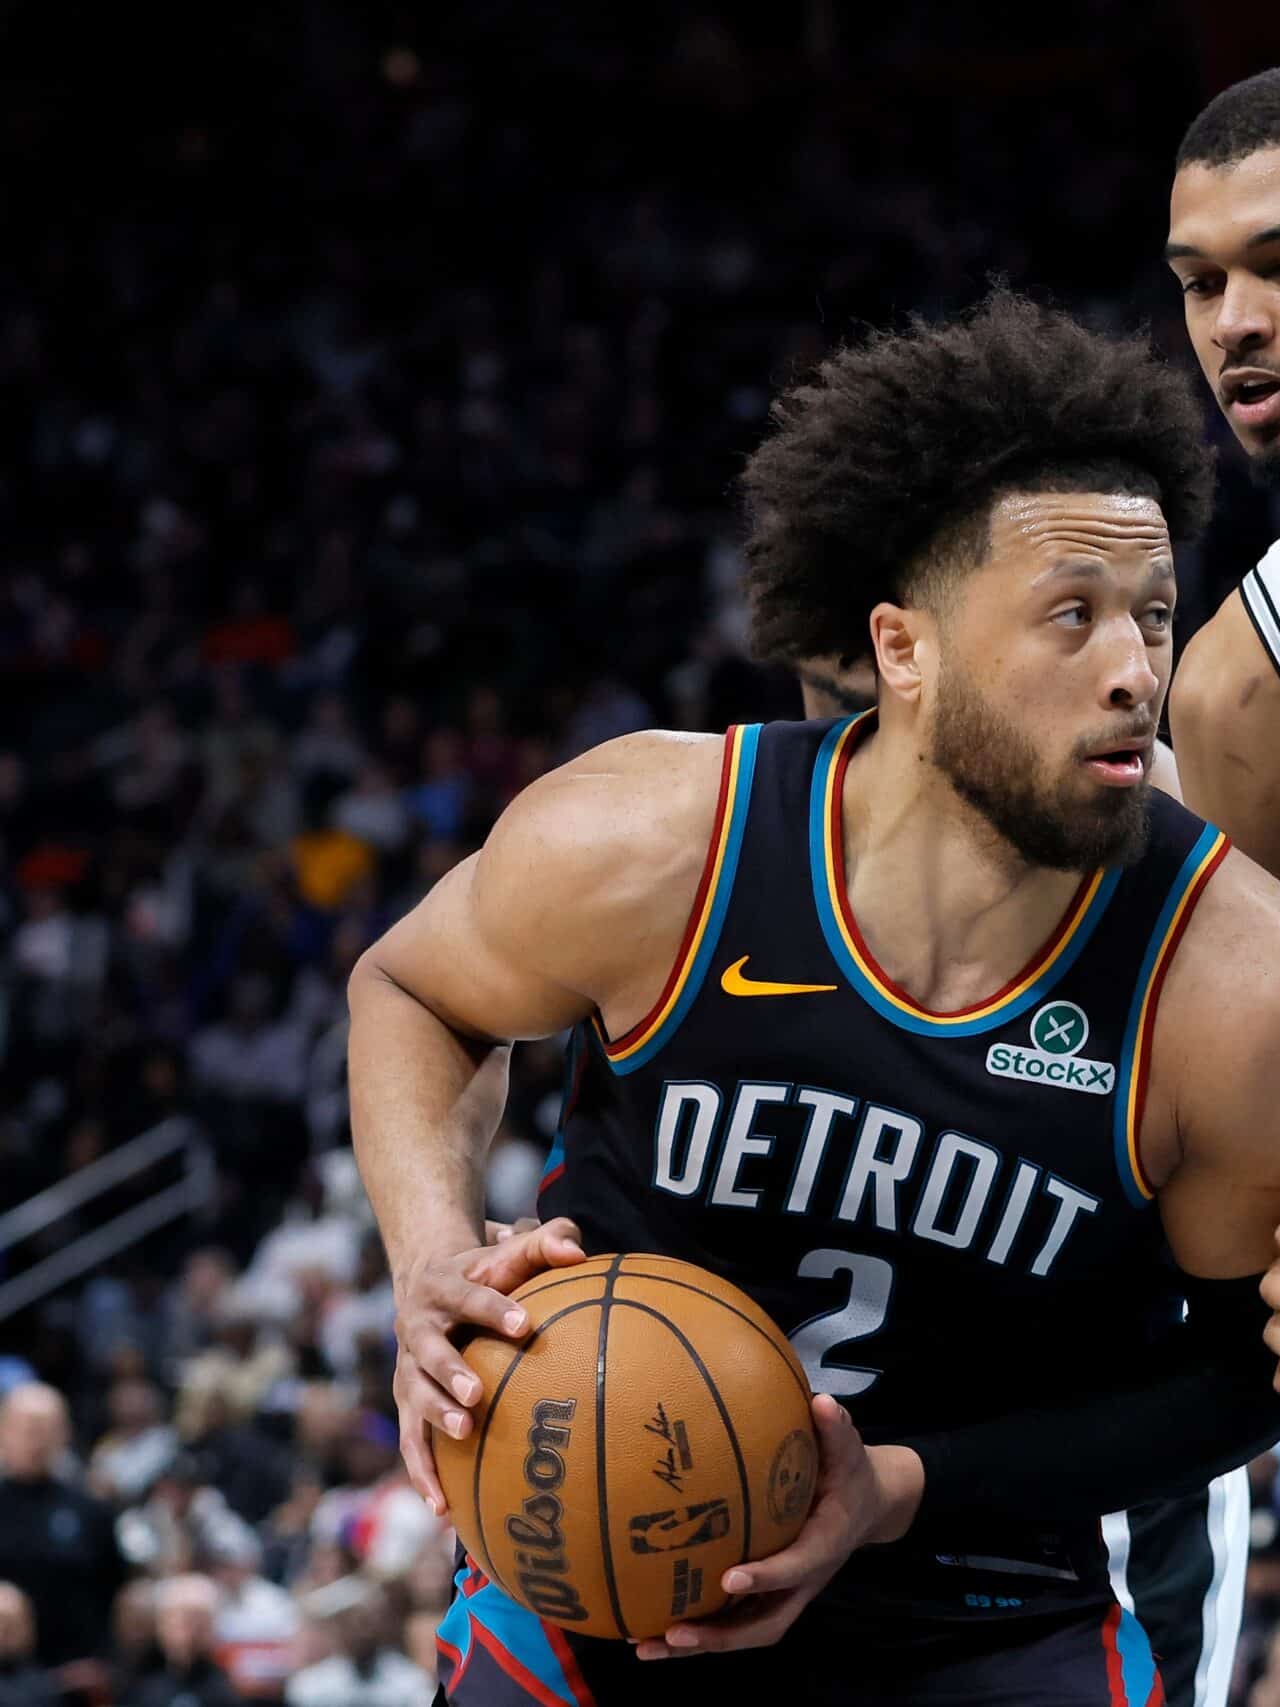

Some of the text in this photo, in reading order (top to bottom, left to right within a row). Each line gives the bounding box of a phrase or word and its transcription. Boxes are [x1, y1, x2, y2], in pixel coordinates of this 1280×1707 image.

[989, 1048, 1112, 1090] StockX
[652, 1080, 1102, 1279] DETROIT
[789, 1248, 894, 1397] 2
[504, 1398, 589, 1622] Wilson
